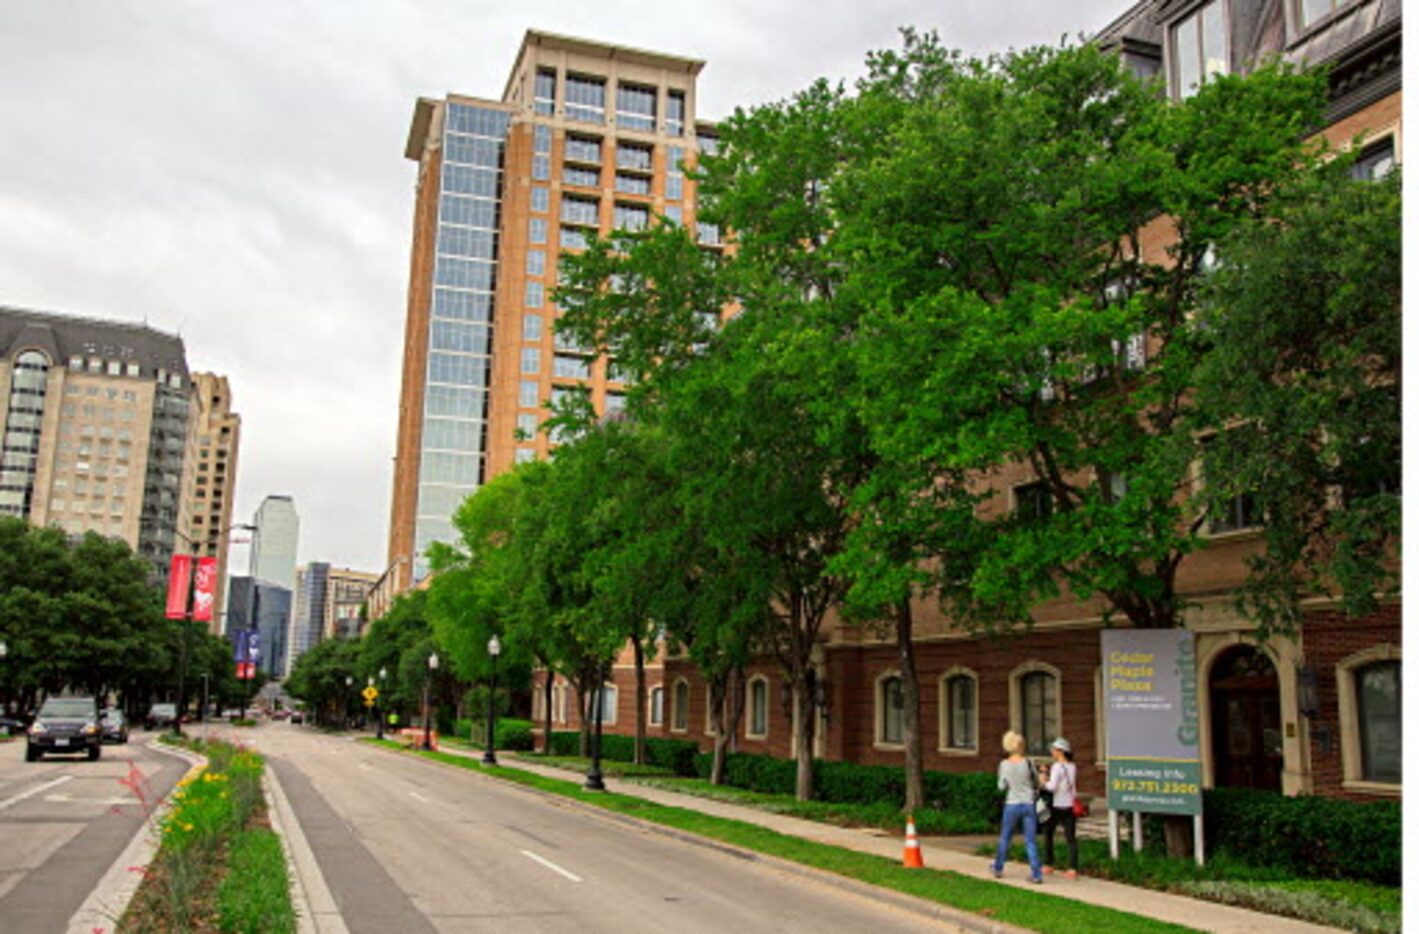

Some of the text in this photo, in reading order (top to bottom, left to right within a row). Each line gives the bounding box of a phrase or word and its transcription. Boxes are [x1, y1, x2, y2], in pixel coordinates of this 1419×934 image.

[1110, 652, 1154, 663] Cedar
[1110, 666, 1154, 678] Maple
[1110, 679, 1153, 691] Plaza
[1119, 767, 1162, 779] Leasing
